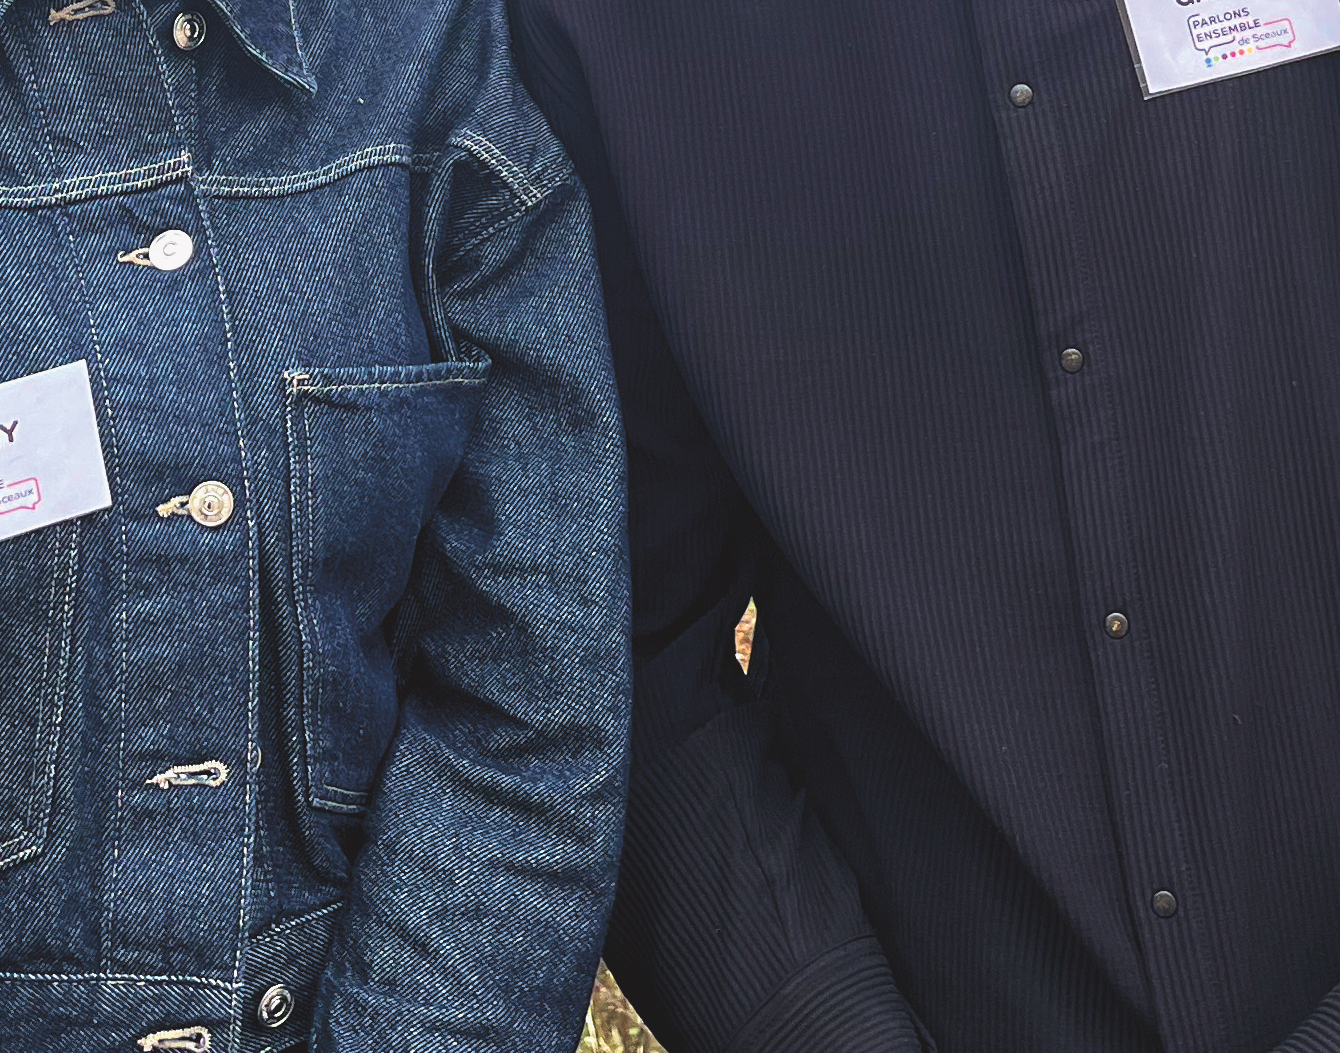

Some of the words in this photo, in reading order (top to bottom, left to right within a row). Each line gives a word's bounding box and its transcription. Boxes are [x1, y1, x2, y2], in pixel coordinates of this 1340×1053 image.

[1192, 7, 1250, 29] PARLONS
[1196, 18, 1261, 43] ENSEMBLE
[1238, 36, 1251, 46] de
[1253, 27, 1290, 43] Sceaux
